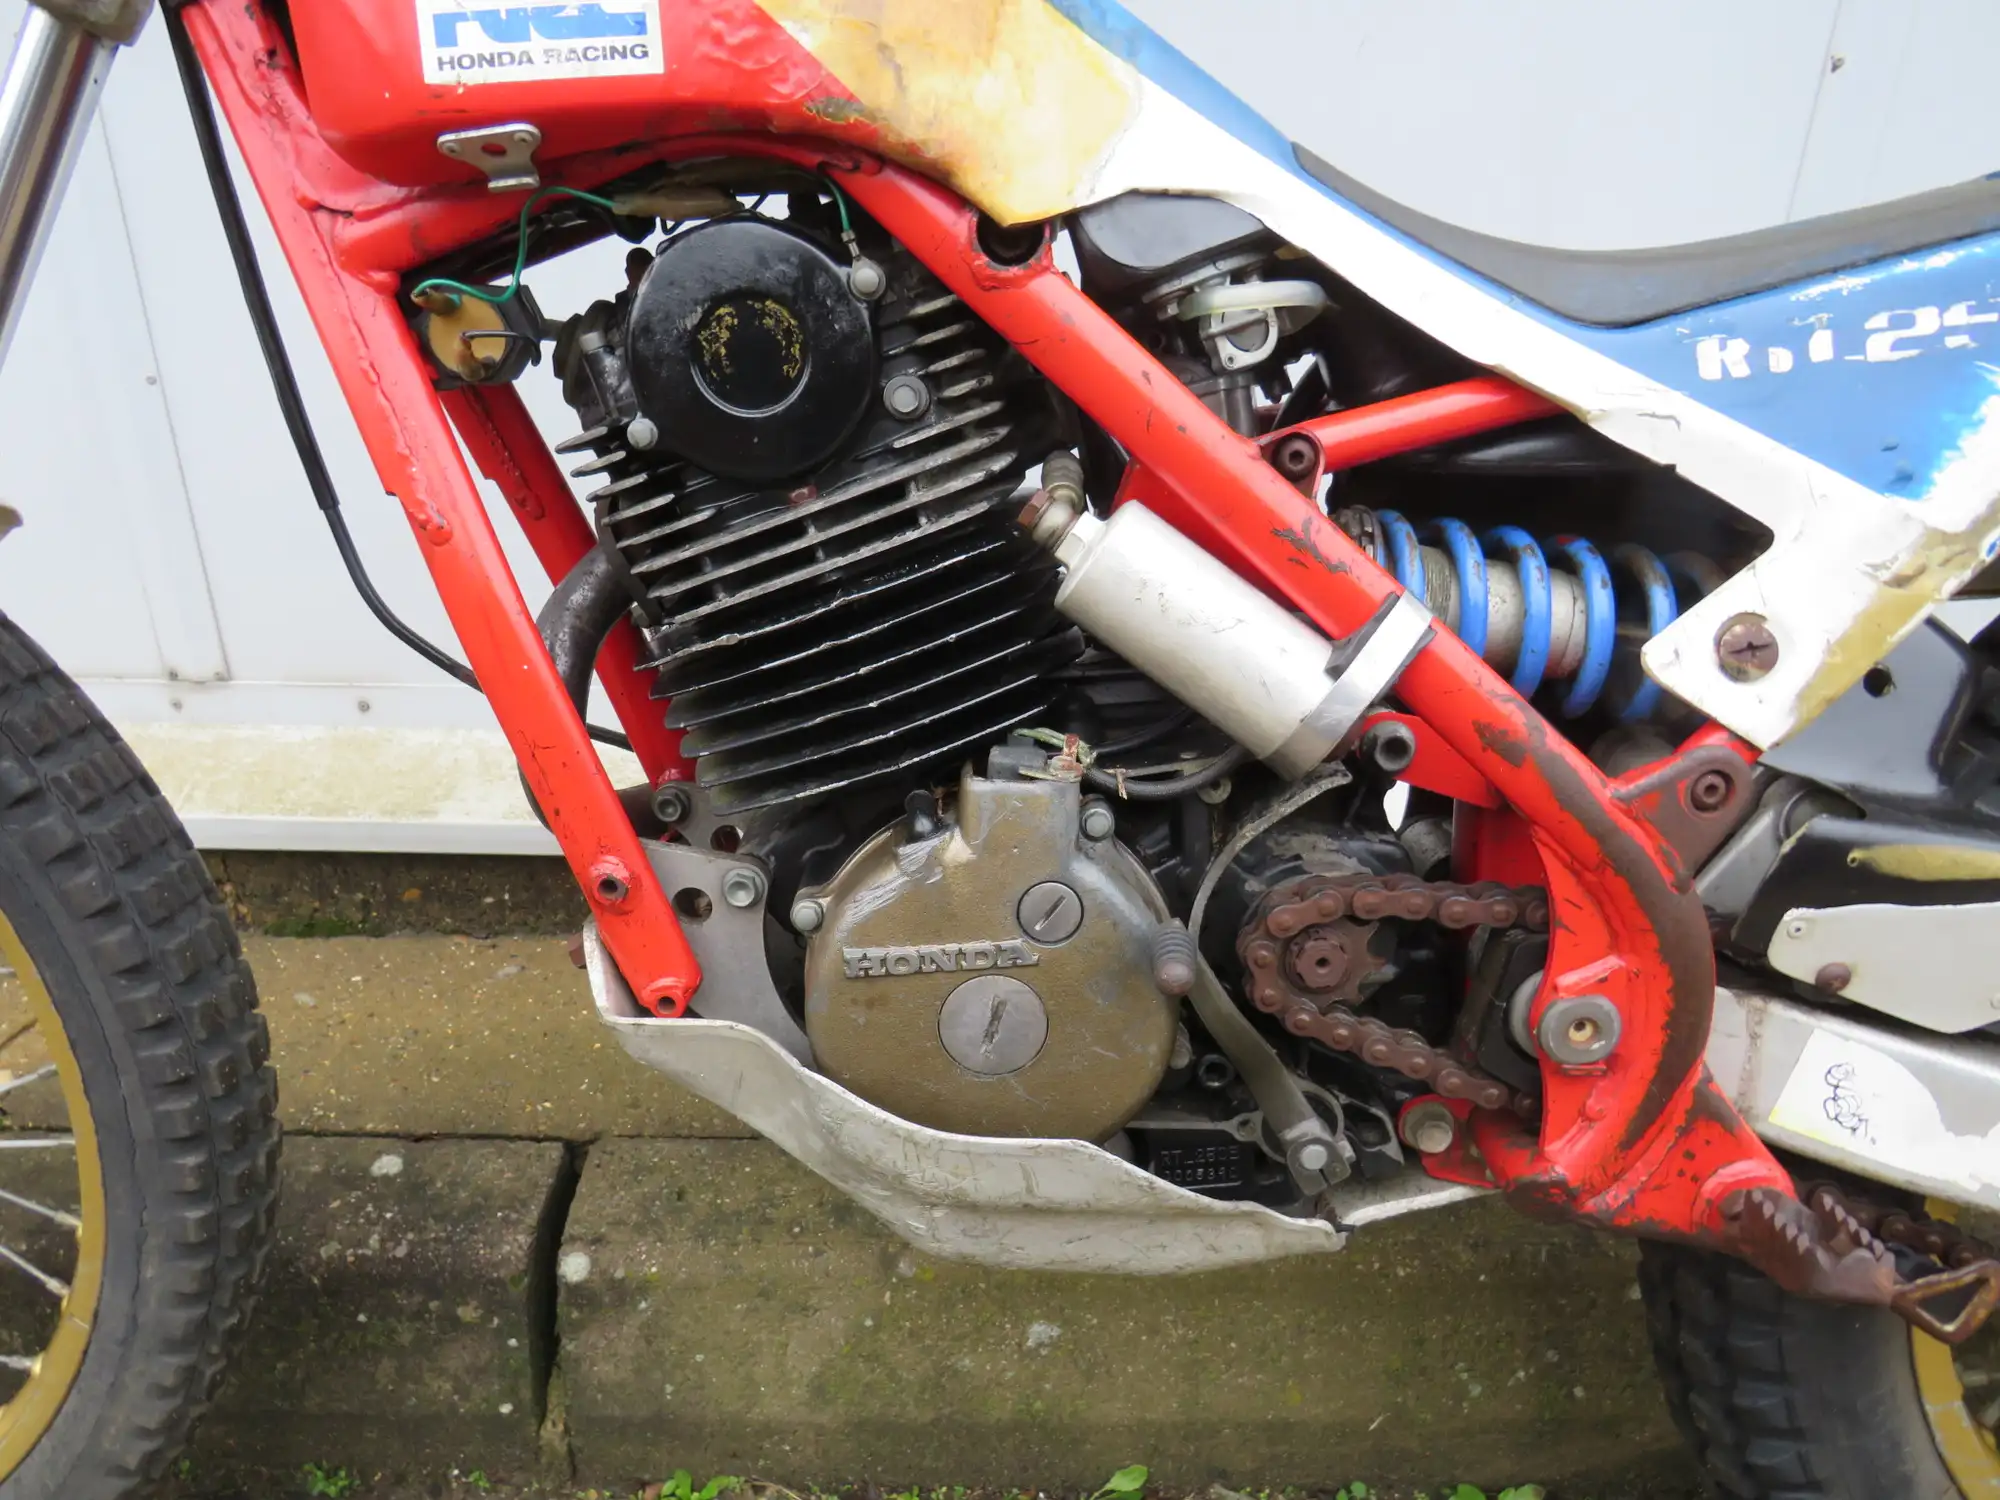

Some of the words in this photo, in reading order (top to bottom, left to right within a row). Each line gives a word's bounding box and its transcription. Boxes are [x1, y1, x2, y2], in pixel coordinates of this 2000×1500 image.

[437, 50, 534, 72] HONDA
[543, 43, 649, 65] RACING
[843, 939, 1040, 979] HONDA
